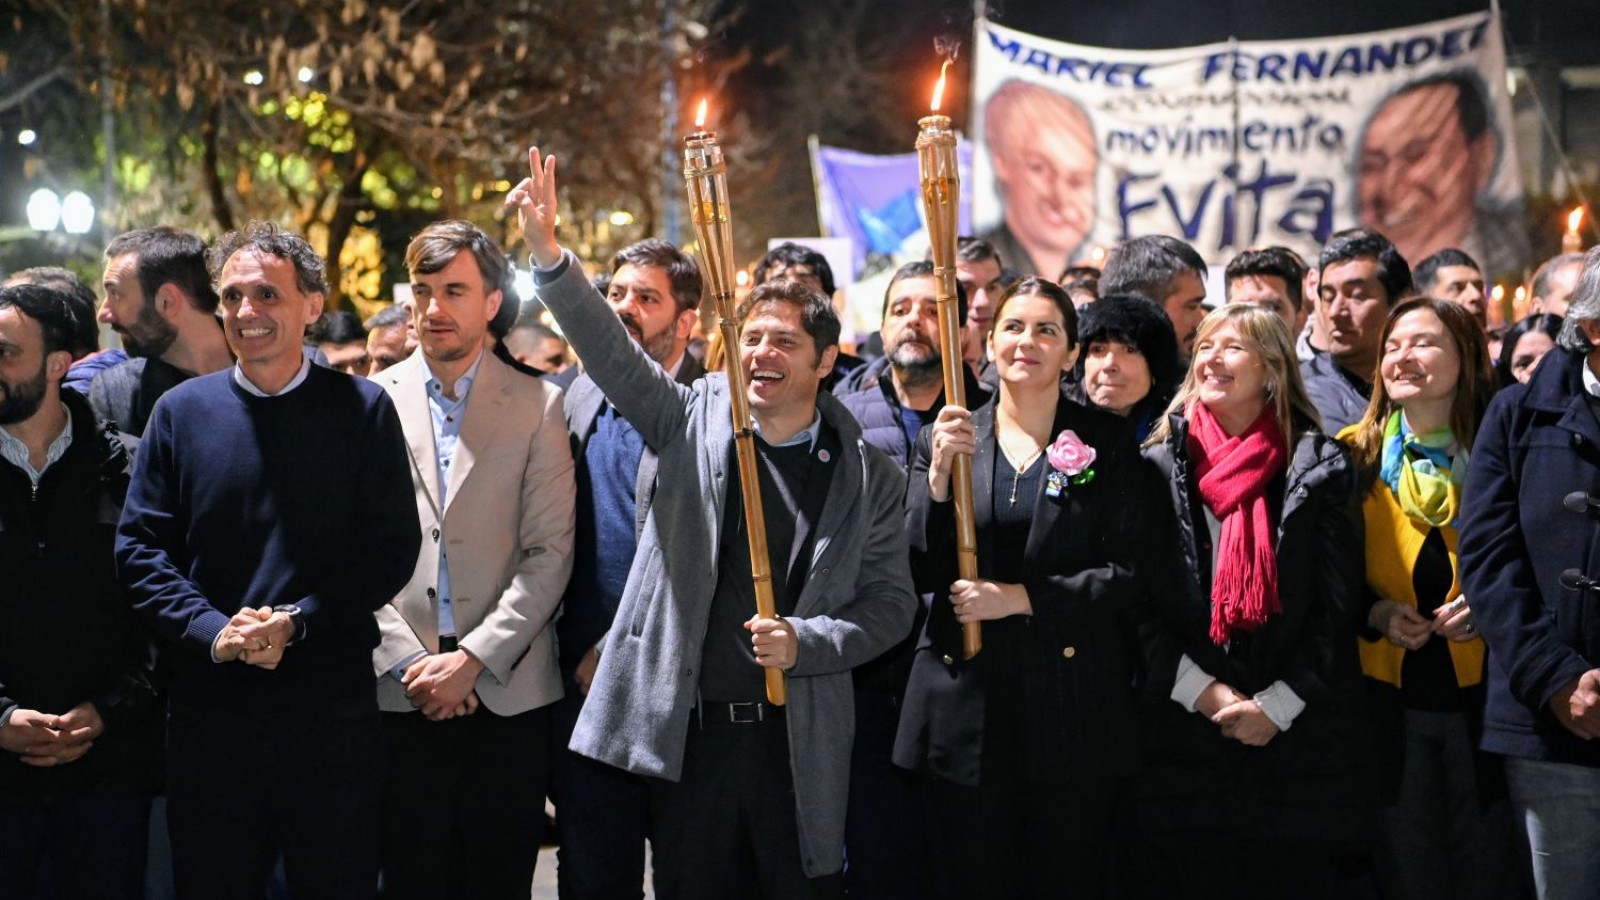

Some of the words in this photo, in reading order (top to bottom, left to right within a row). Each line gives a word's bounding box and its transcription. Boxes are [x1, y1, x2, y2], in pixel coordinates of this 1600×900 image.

[988, 30, 1152, 87] MARIEL
[1106, 114, 1344, 157] movimiento
[1117, 159, 1334, 250] Evita
